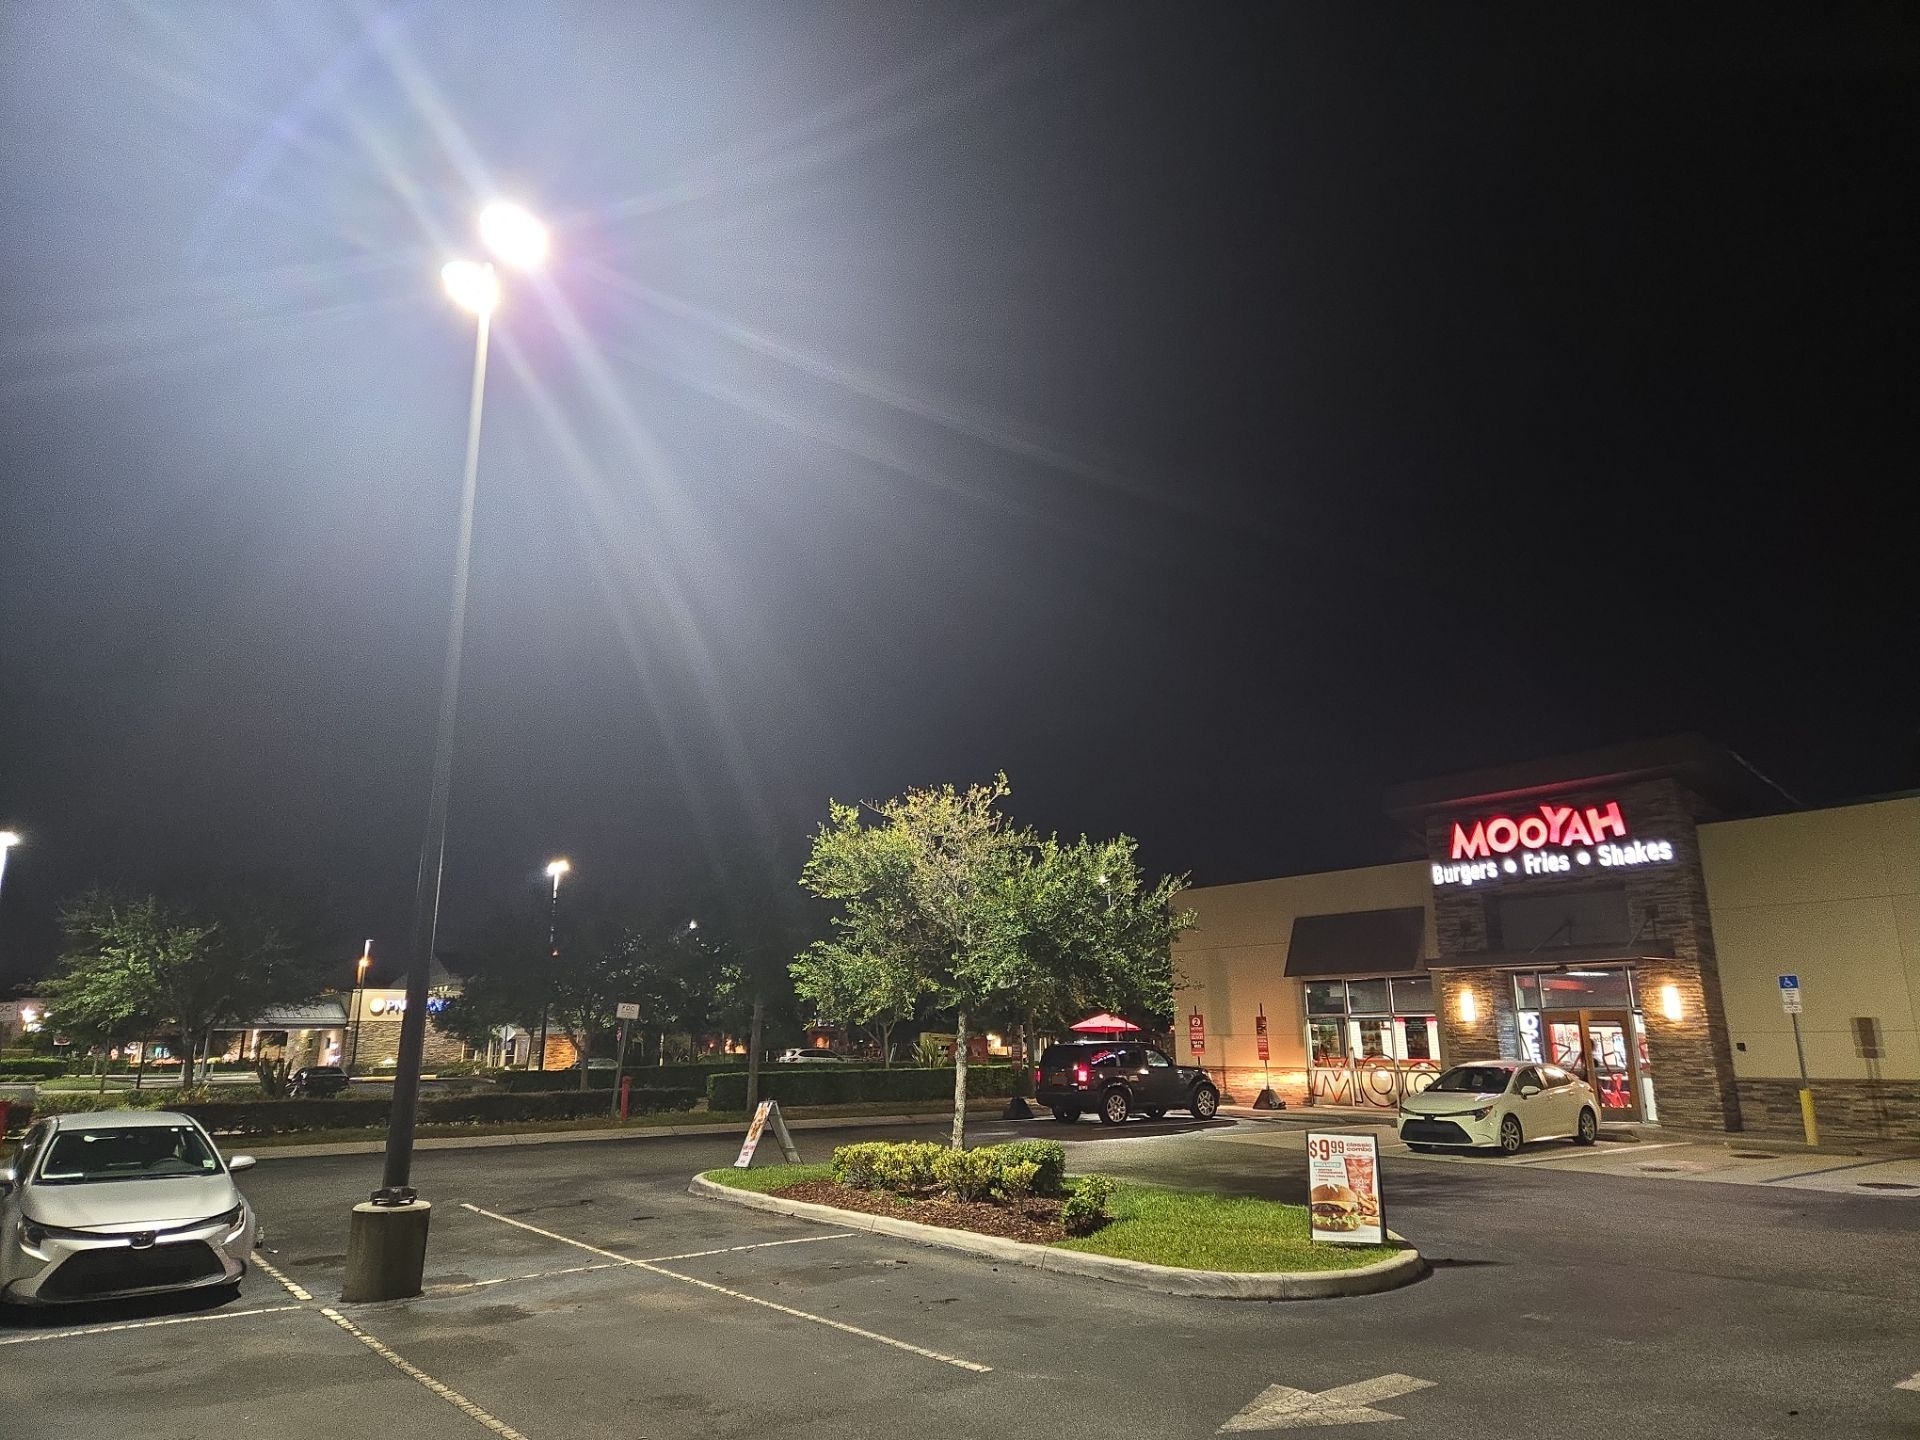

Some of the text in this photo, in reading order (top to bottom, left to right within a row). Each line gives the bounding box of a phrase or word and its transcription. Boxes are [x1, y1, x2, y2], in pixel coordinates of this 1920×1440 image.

[1451, 801, 1627, 860] MOOYAH
[1432, 840, 1673, 887] Burgers Fries Shakes
